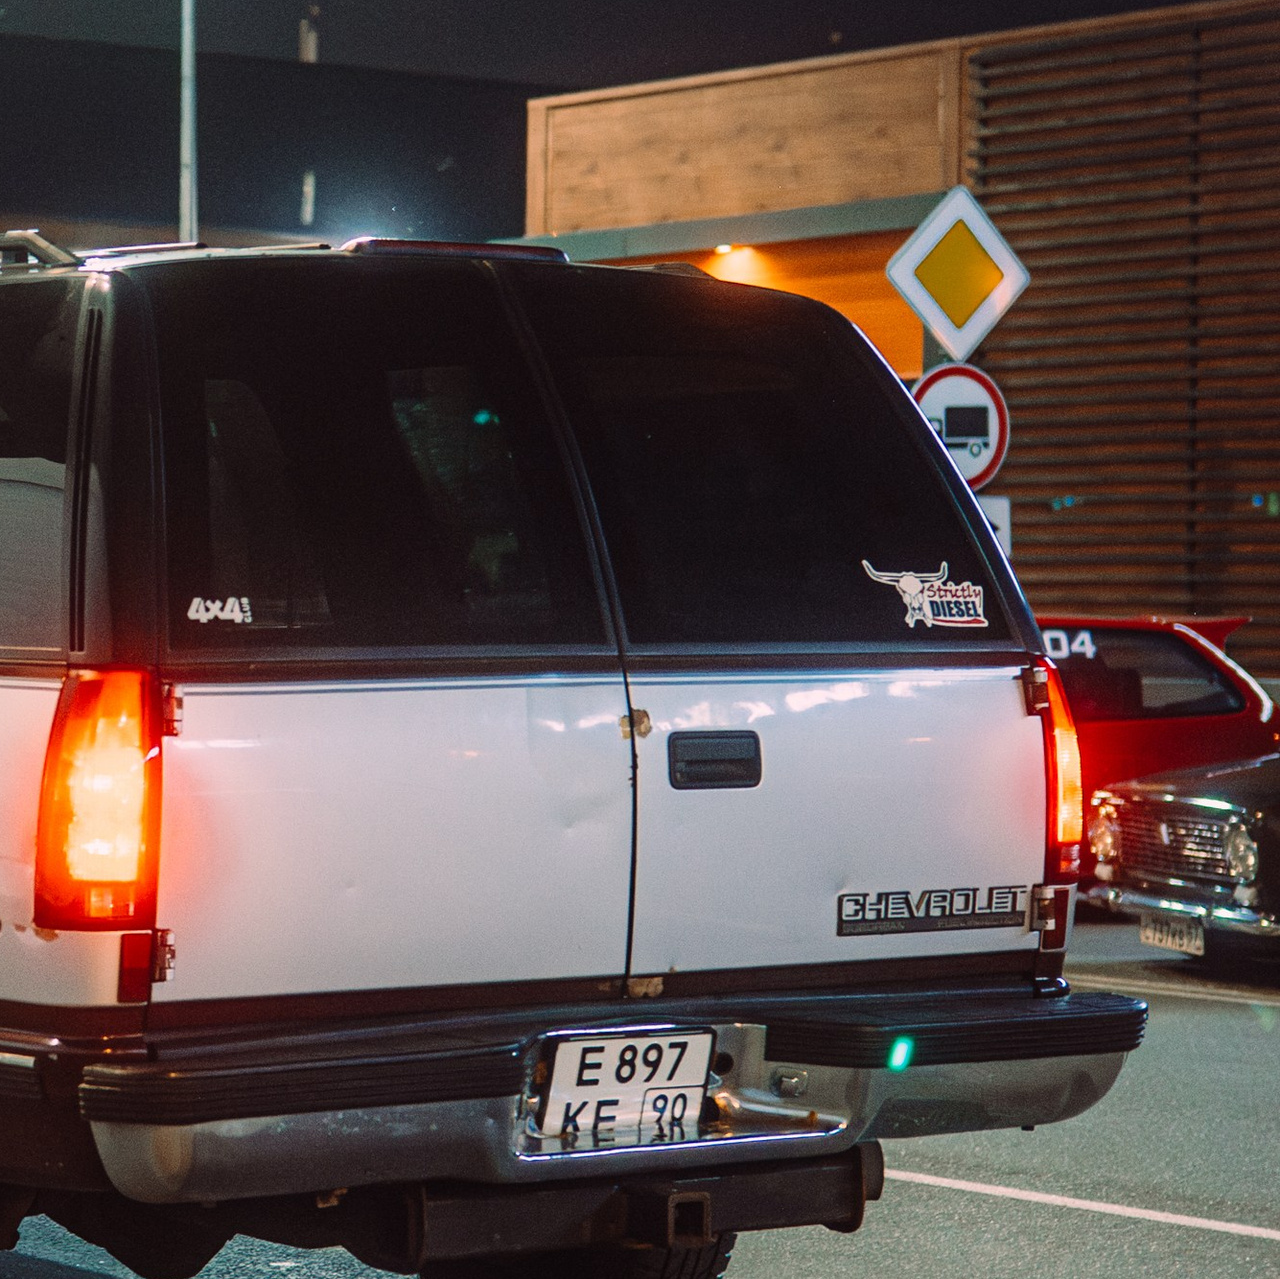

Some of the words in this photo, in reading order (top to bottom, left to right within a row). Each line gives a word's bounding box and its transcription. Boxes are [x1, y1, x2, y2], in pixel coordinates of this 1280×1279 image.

[927, 583, 981, 604] Strictly
[187, 597, 243, 623] 4x4
[929, 600, 981, 618] DIESEL
[838, 885, 1028, 921] CHEVROLET
[576, 1046, 605, 1086] E
[615, 1041, 688, 1084] 897
